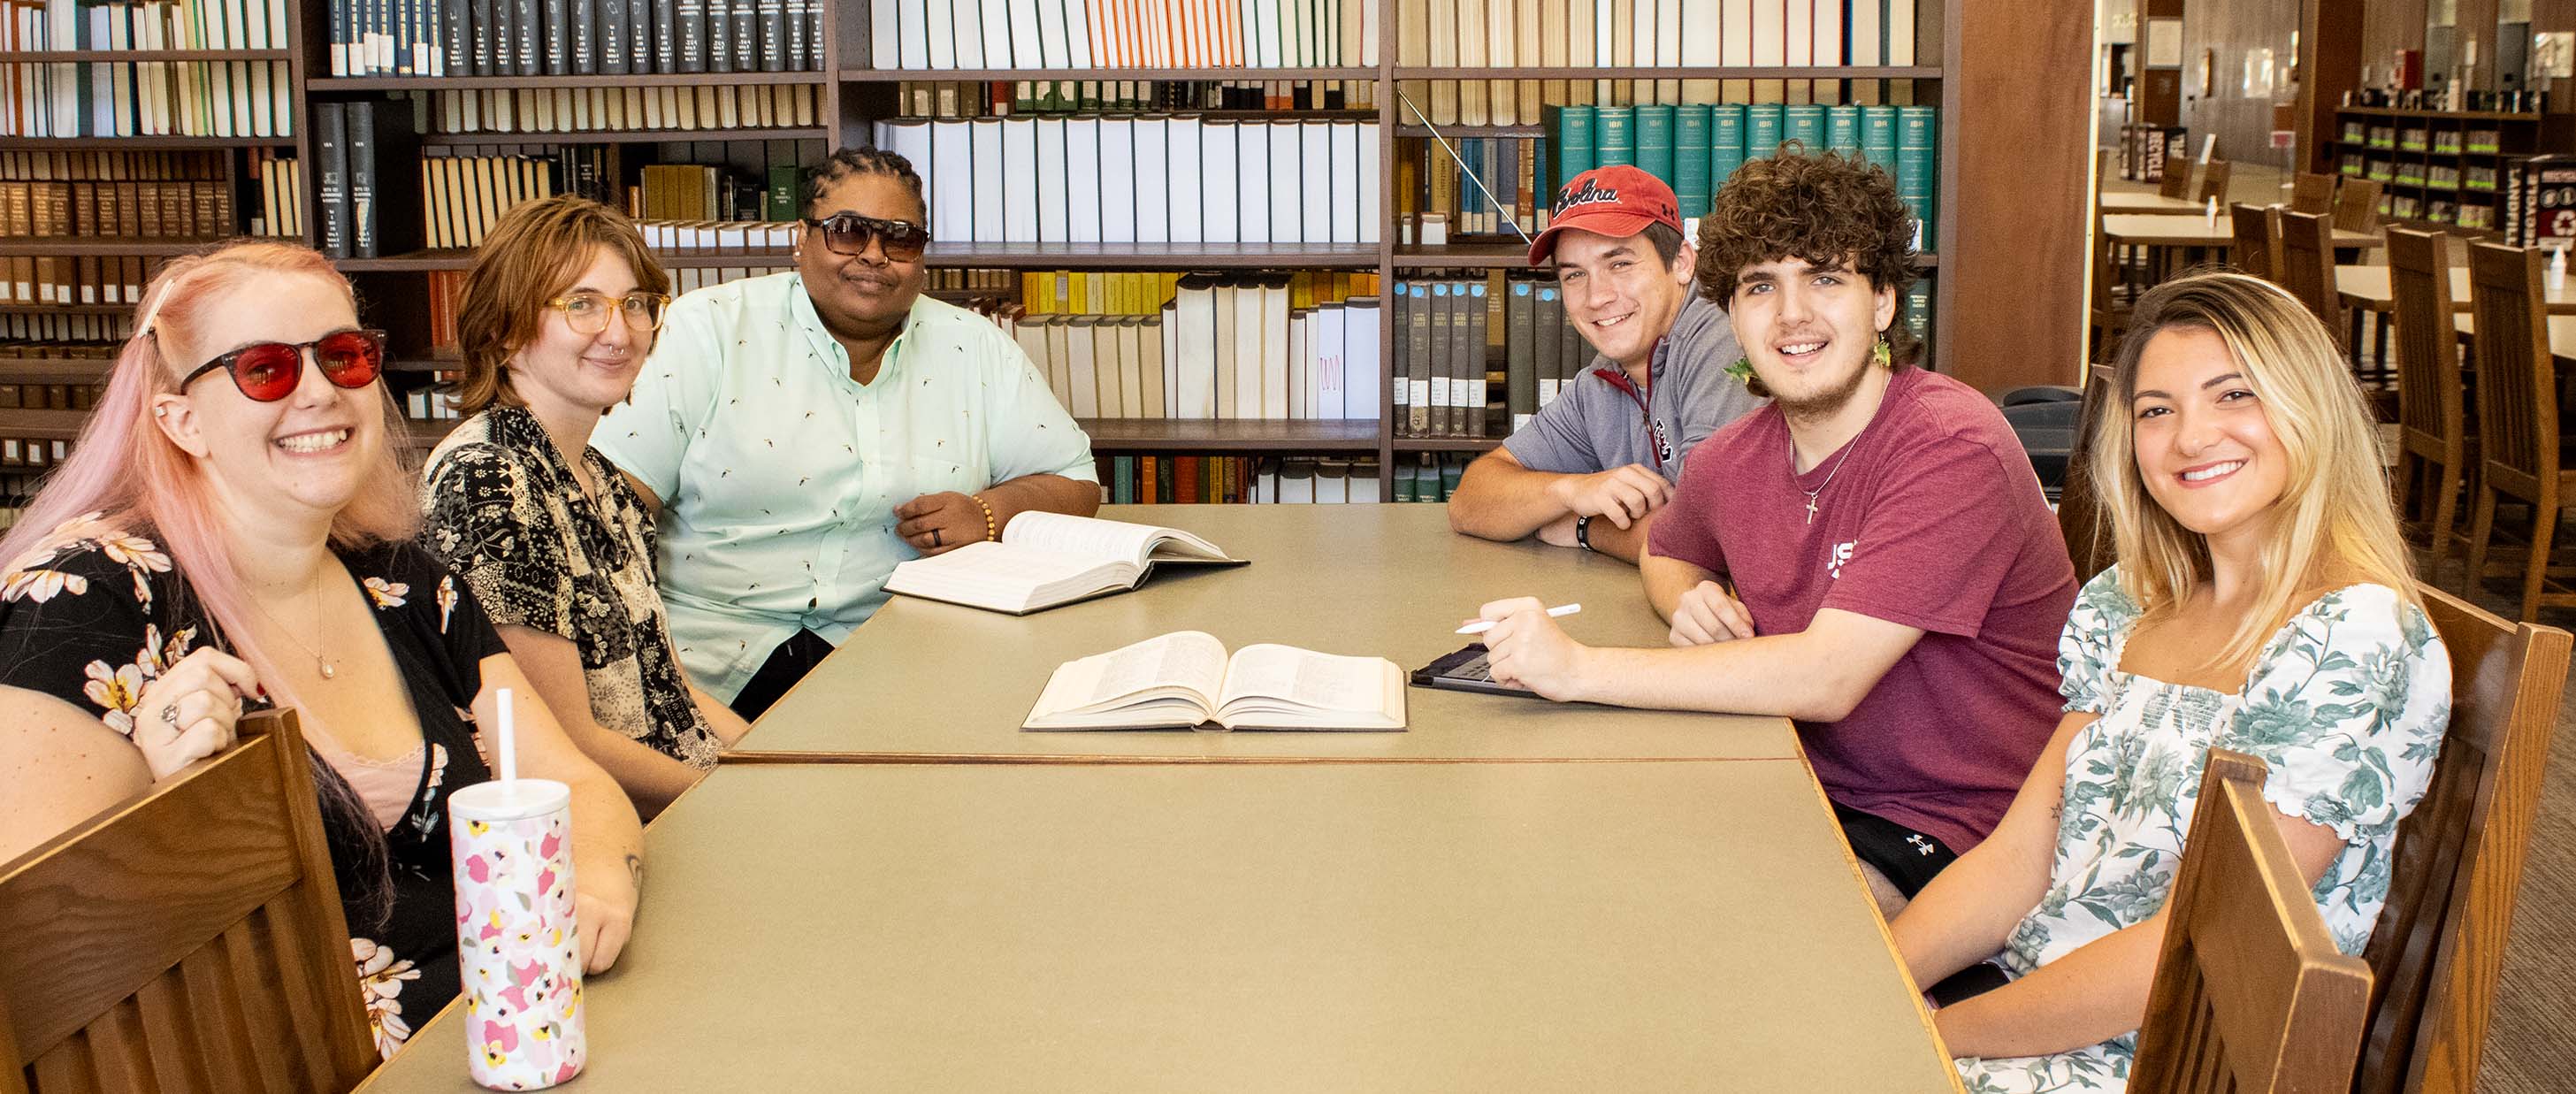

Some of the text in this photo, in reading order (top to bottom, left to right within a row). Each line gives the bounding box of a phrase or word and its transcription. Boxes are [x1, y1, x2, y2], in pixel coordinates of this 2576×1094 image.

[2147, 131, 2164, 178] RECYCLE
[1553, 178, 1618, 219] Carolina
[2505, 169, 2521, 247] LANDFILL
